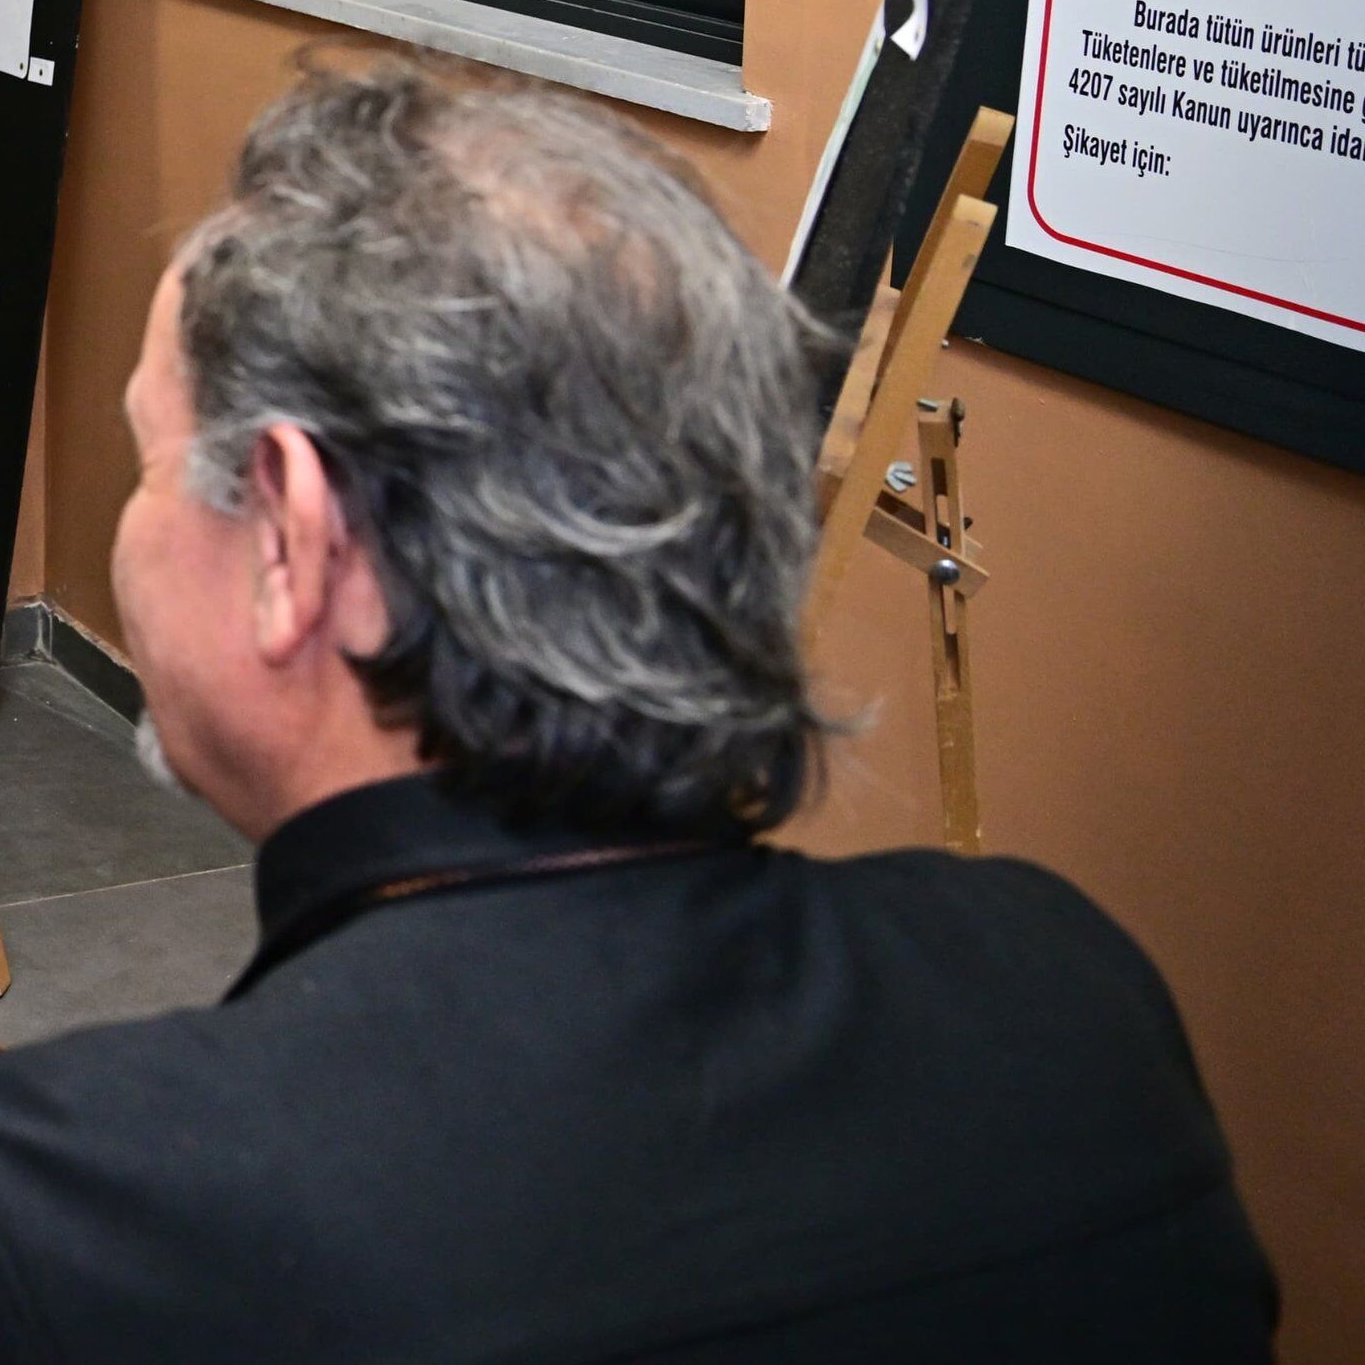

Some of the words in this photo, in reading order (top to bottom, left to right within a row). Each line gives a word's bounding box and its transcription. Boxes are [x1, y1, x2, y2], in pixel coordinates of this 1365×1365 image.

[1133, 0, 1200, 39] Burada
[1206, 14, 1255, 50] tütün
[1261, 24, 1341, 67] ürünleri
[1068, 67, 1114, 101] 4207
[1118, 85, 1167, 116] sayılı
[1172, 90, 1231, 130] Kanun
[1237, 110, 1324, 151] uyarınca
[1082, 29, 1187, 78] Tüketenlere
[1193, 59, 1214, 84] ve
[1221, 59, 1355, 114] tüketilmesine
[1063, 123, 1127, 166] Şikayet
[1132, 141, 1171, 178] için:
